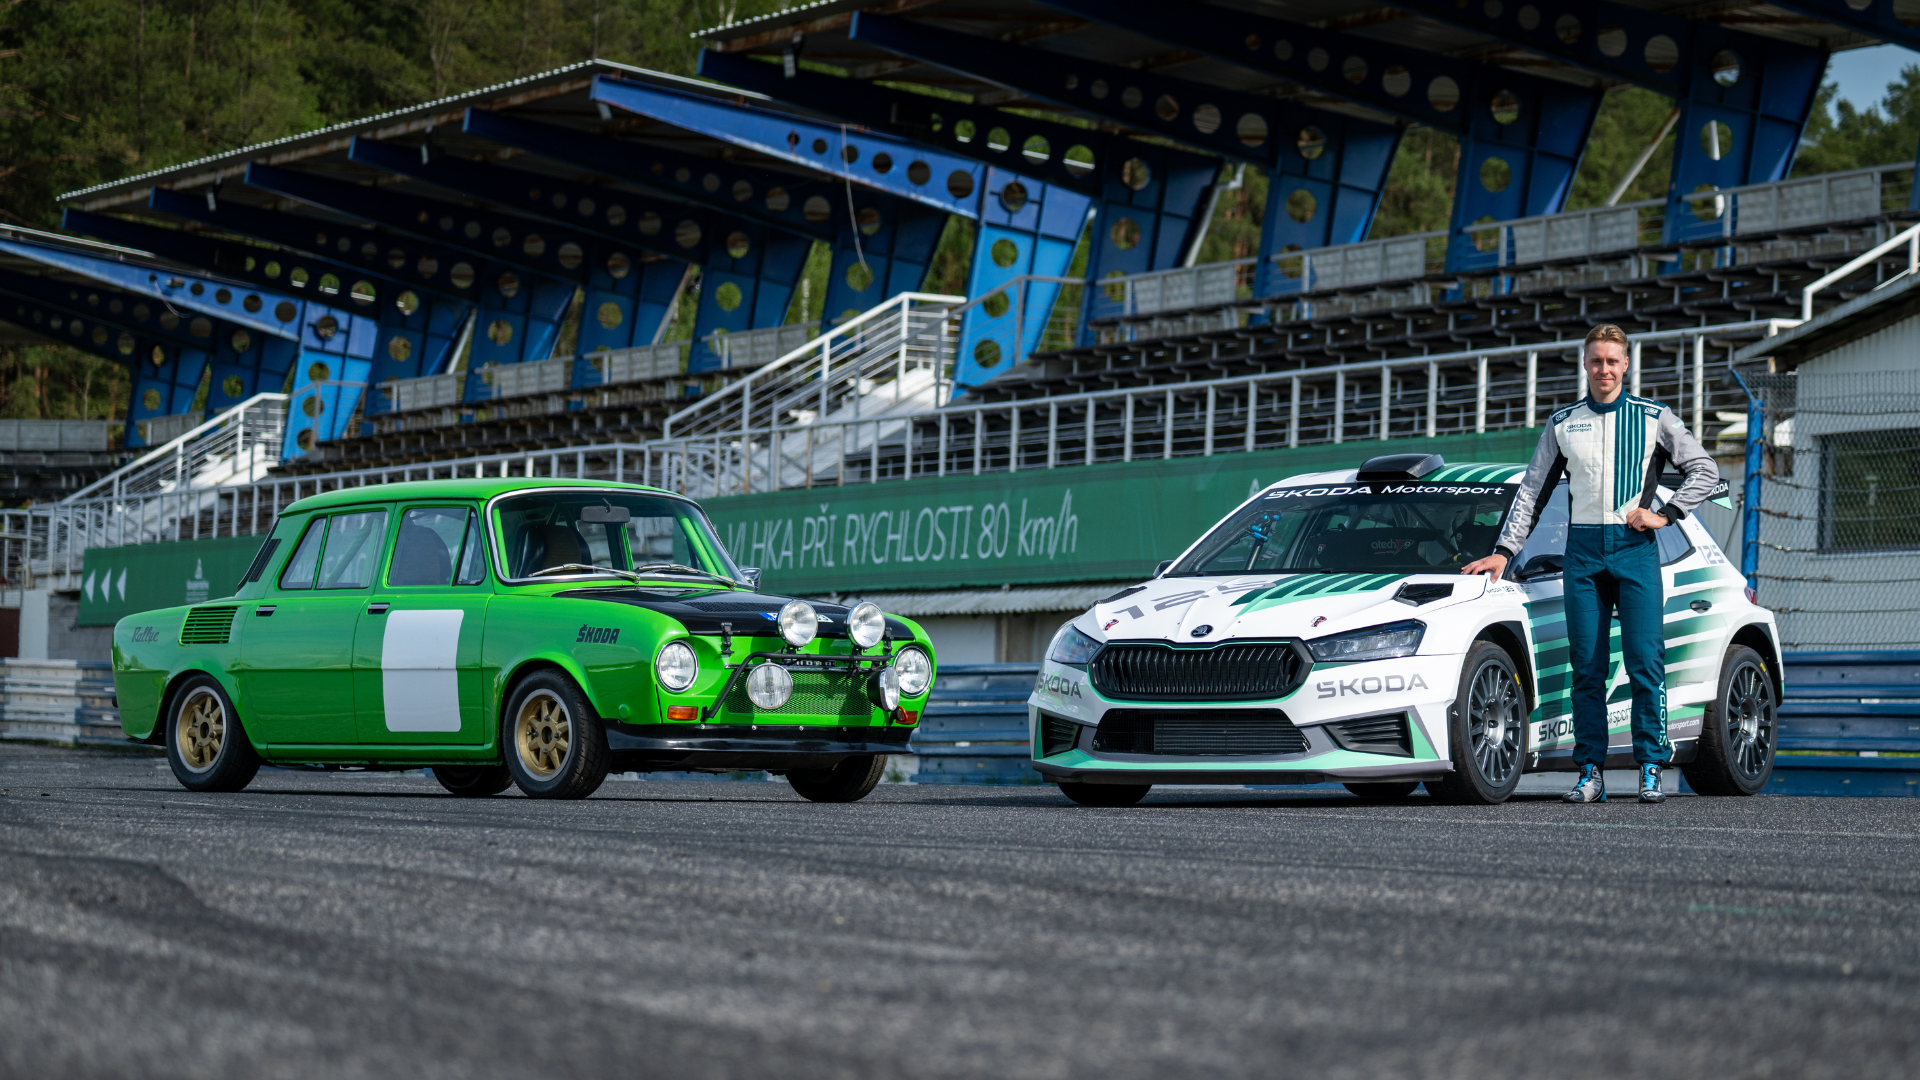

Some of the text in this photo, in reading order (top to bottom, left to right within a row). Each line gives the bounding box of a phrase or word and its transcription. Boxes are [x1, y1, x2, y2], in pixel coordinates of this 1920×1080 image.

[1381, 485, 1505, 496] Motorsport
[728, 488, 1078, 570] VLHKA PŘI RYCHLOSTI 80 km/h
[1697, 544, 1725, 565] 125
[131, 626, 160, 643] Rallye
[576, 624, 620, 644] ŠKODA
